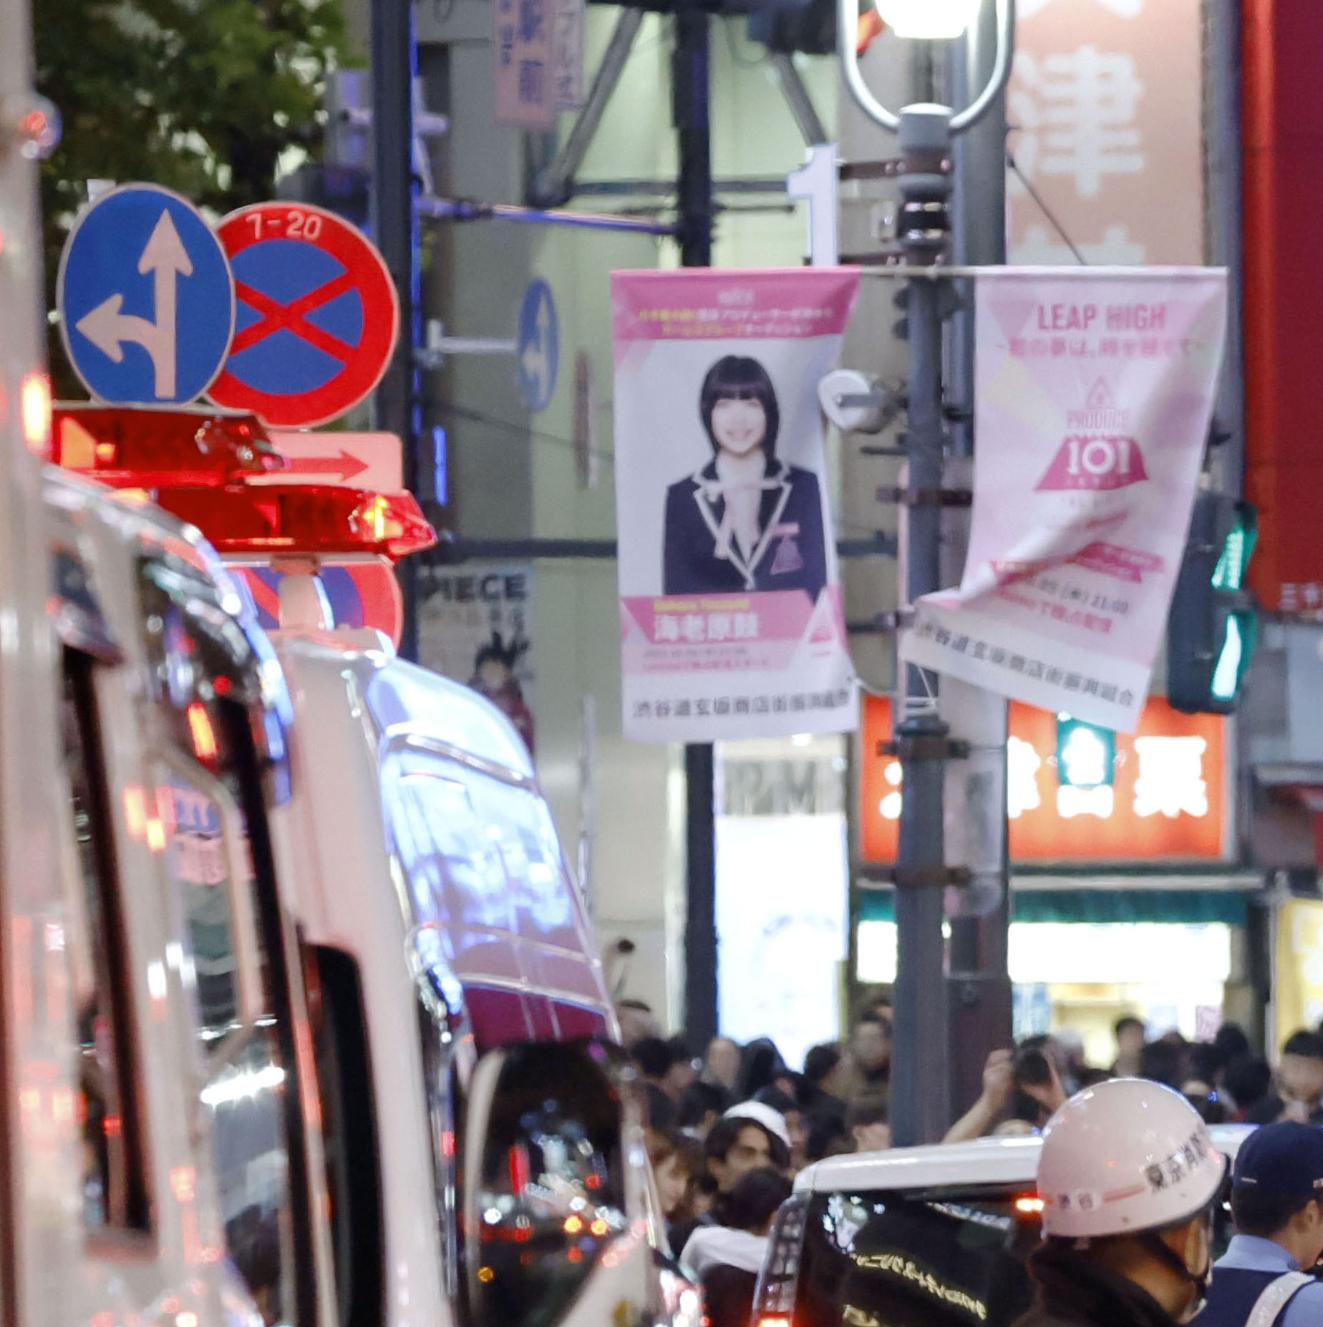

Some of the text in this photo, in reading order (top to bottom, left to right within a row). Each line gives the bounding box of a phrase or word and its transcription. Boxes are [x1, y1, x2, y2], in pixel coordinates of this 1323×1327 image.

[245, 209, 323, 241] 1-20
[1038, 302, 1167, 331] LEAP HIGH
[1067, 440, 1132, 476] 101
[425, 574, 525, 602] IECE
